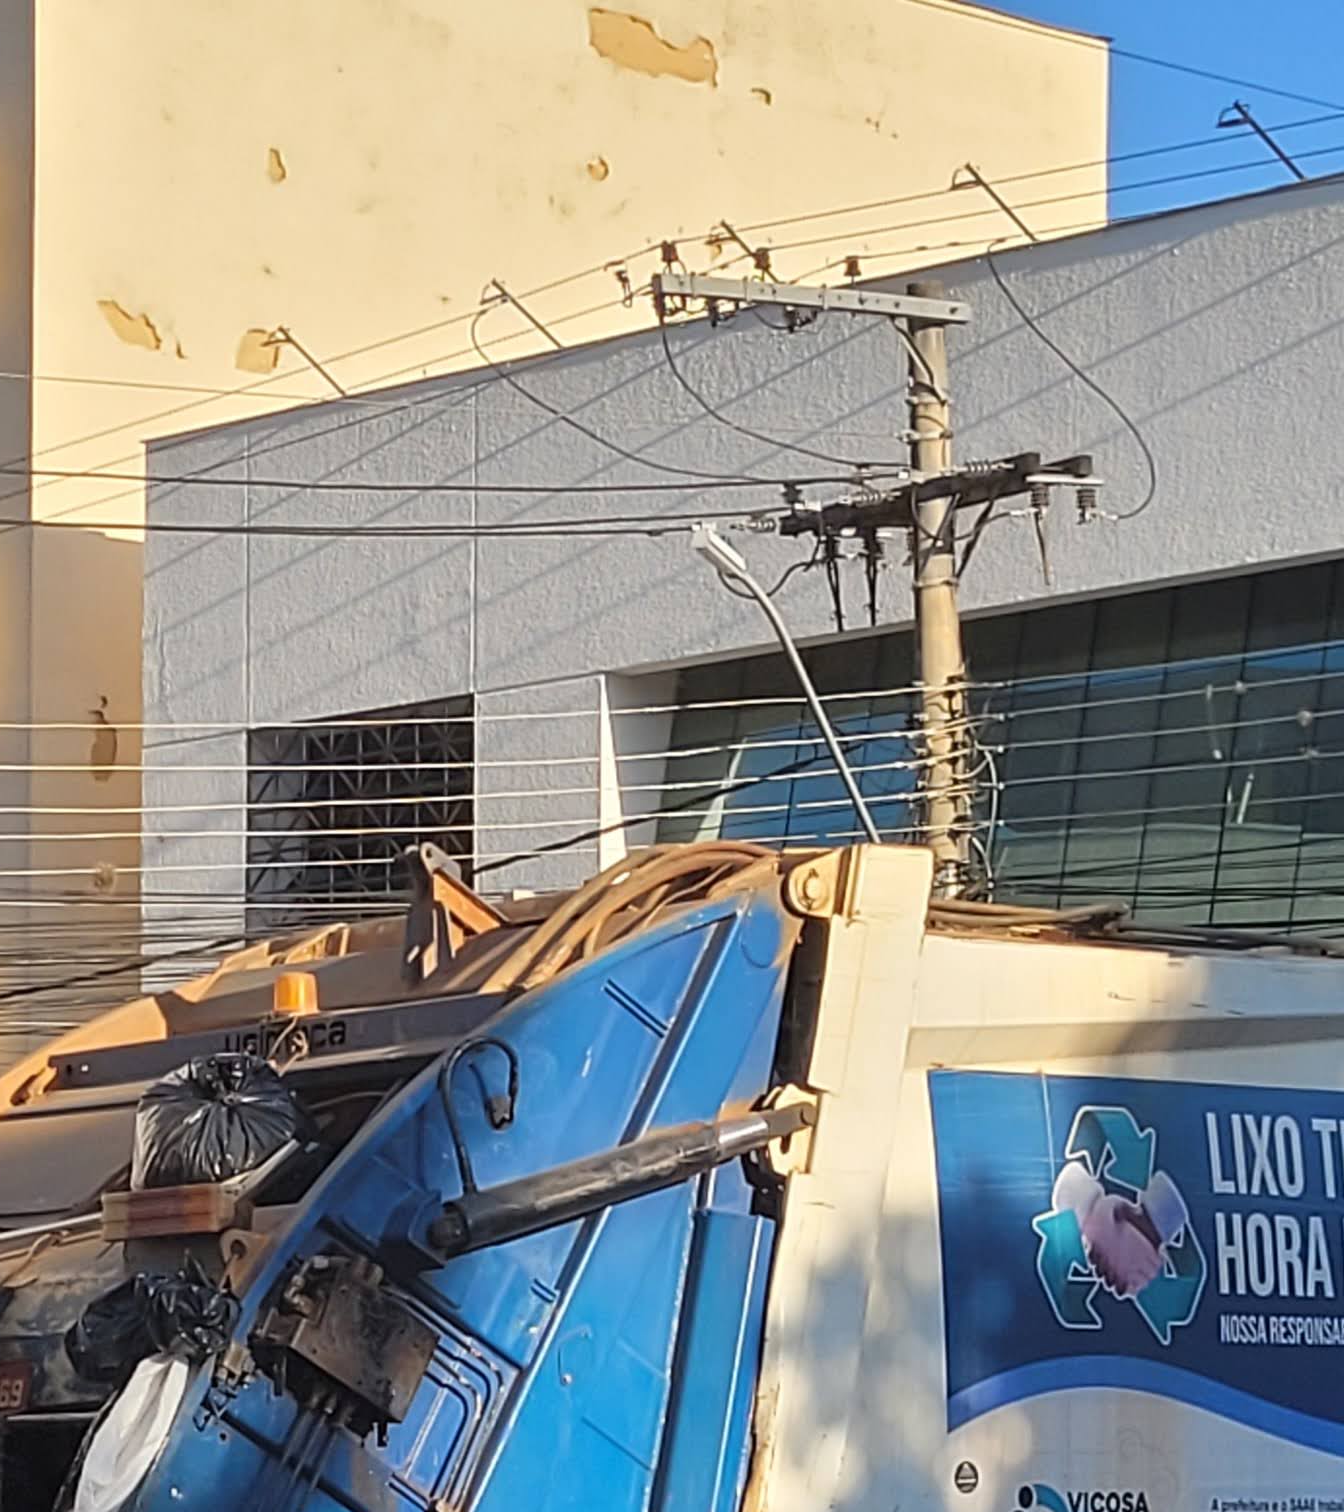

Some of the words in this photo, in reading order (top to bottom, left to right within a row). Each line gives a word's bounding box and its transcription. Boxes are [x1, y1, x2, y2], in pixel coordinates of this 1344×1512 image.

[1206, 1111, 1305, 1198] LIXO
[1214, 1211, 1335, 1299] HORA
[1219, 1313, 1267, 1345] NOSSA
